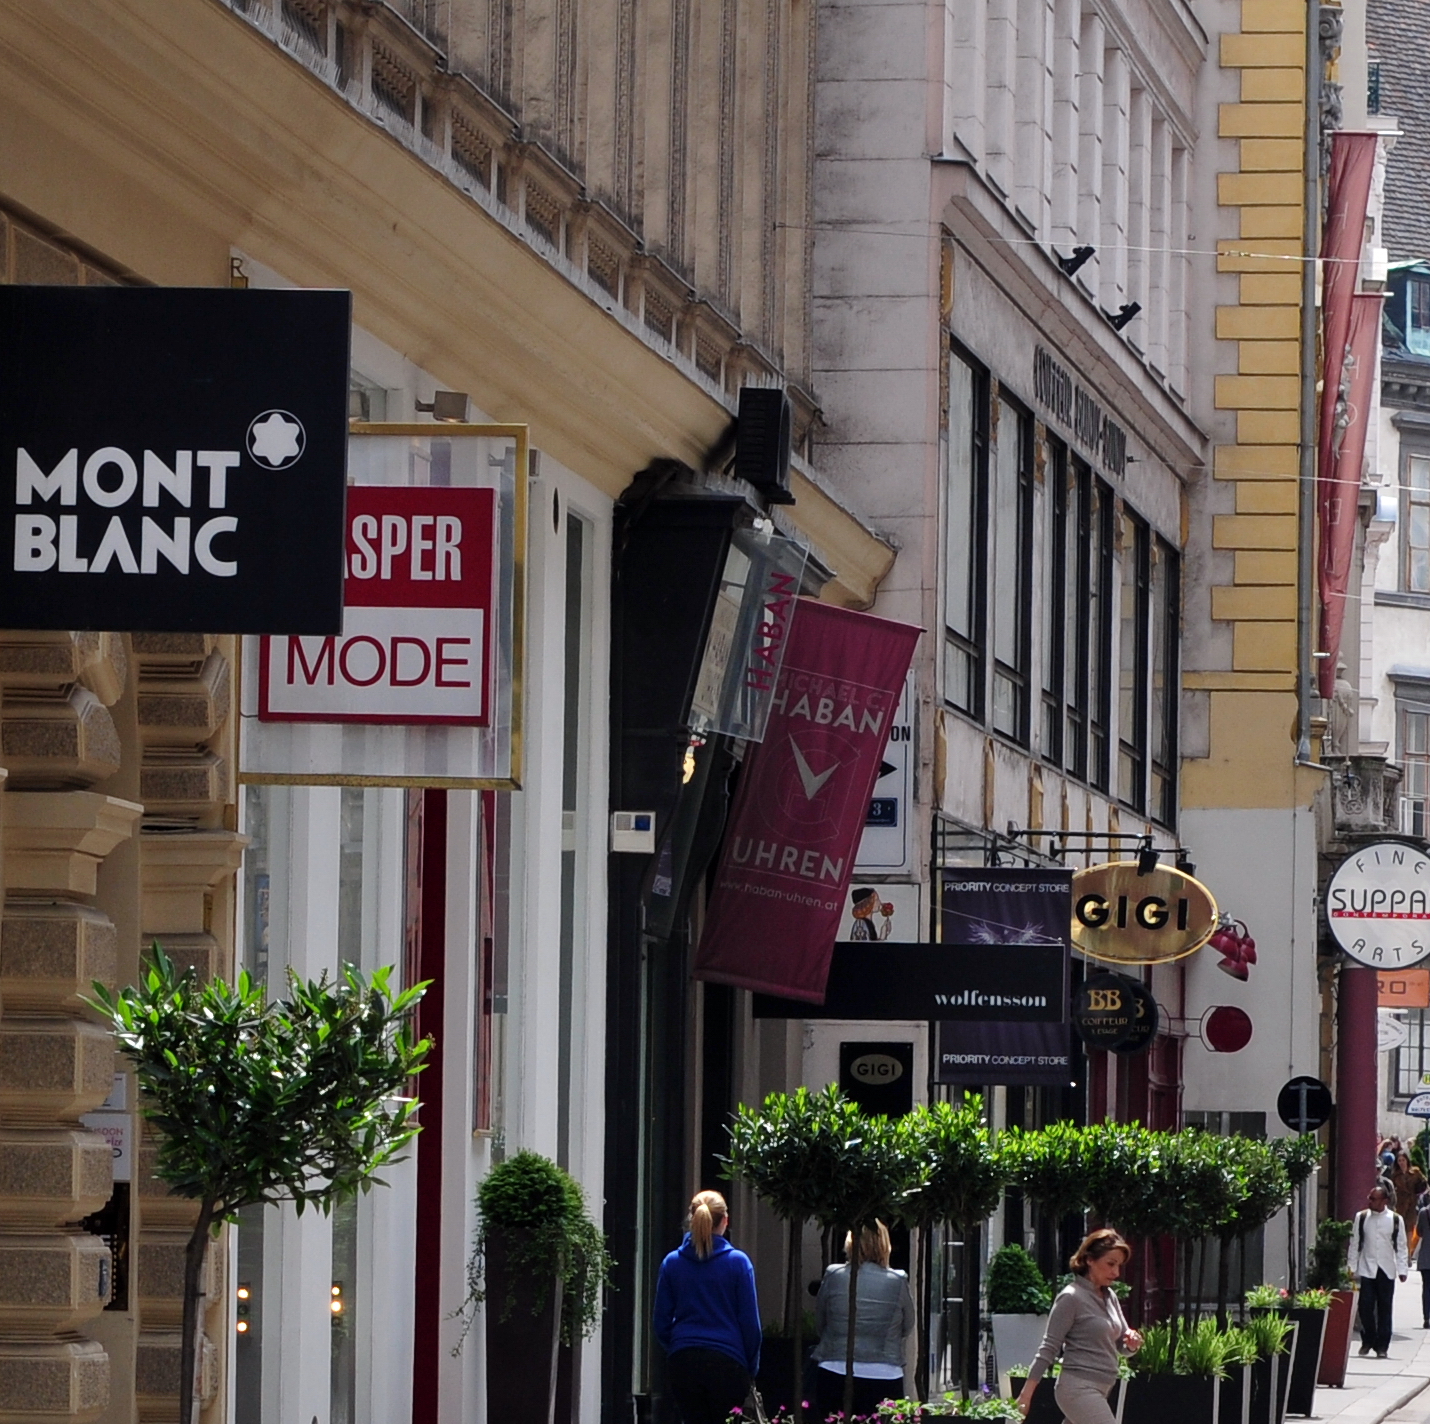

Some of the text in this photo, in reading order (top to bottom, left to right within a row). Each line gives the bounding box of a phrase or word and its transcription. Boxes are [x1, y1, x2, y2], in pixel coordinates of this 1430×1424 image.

[14, 446, 240, 509] MONT
[12, 514, 239, 577] BLANC
[344, 514, 462, 582] SPER
[745, 572, 797, 691] HABAN
[286, 634, 472, 688] MODE
[771, 689, 884, 737] HABAN
[731, 836, 844, 883] UHREN
[1355, 850, 1426, 875] FINE
[944, 881, 1070, 893] PRIORITY CONCEPT STORE
[1075, 893, 1188, 931] GIGI
[1352, 938, 1424, 962] ARTS
[934, 989, 1047, 1008] wolfensson
[1087, 989, 1122, 1011] BB
[856, 1062, 895, 1077] GIGI
[942, 1053, 1069, 1066] PRIORITY CONCEPT STORE
